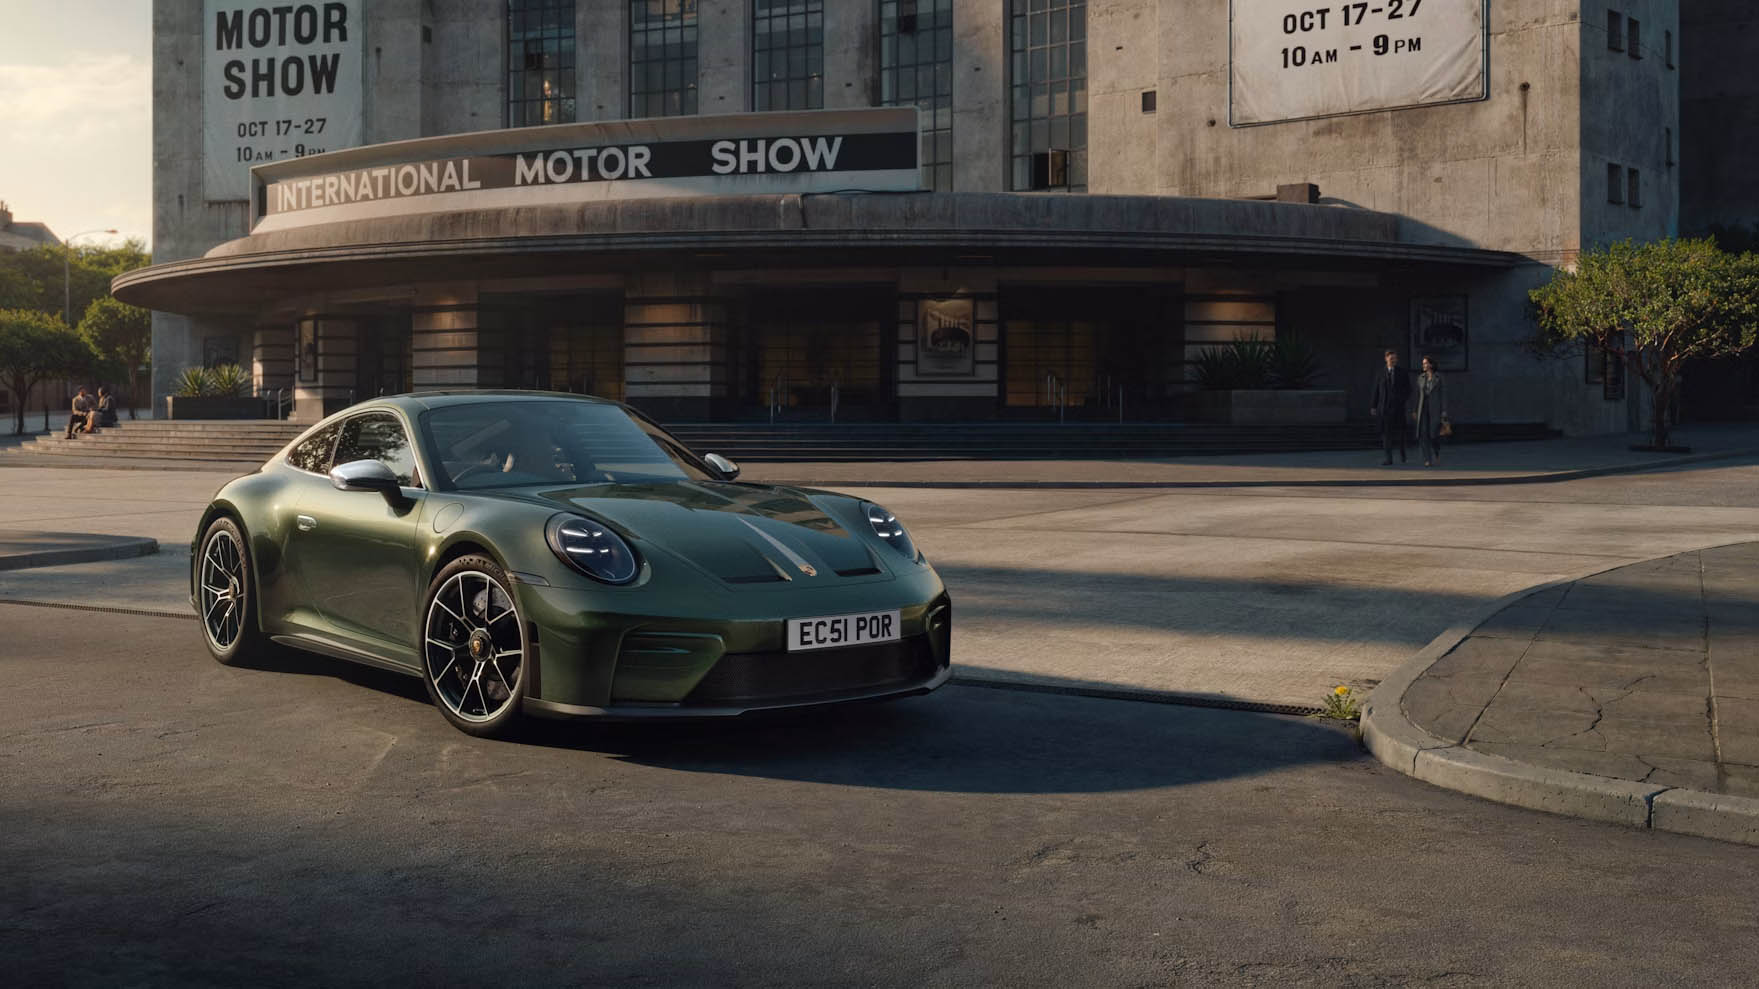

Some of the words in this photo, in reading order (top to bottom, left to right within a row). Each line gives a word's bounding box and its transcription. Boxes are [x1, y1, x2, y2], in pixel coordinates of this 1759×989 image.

[216, 2, 348, 50] MOTOR
[1283, 8, 1330, 35] OCT
[1342, 0, 1422, 26] 17-27
[223, 53, 340, 100] SHOW
[238, 121, 268, 138] OCT
[276, 117, 327, 136] 17-27
[277, 159, 481, 212] INTERNATIONAL
[514, 146, 653, 186] MOTOR
[711, 136, 843, 174] SHOW
[856, 614, 892, 640] POR
